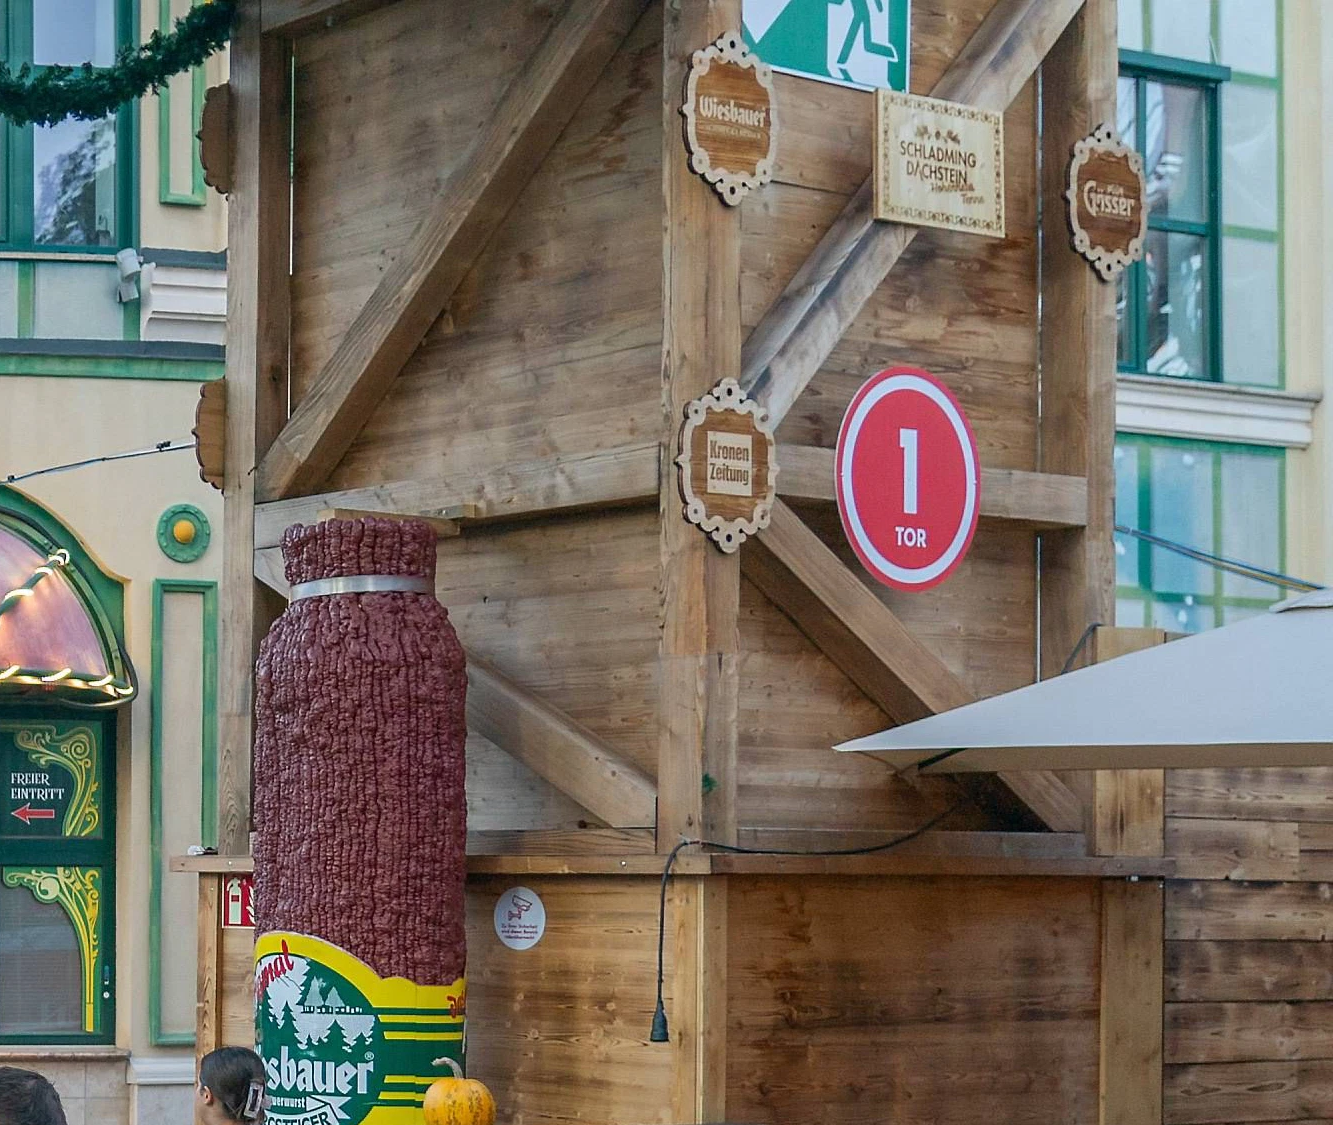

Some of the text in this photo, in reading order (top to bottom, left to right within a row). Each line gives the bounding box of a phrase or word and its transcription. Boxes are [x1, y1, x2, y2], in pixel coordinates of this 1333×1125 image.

[700, 95, 766, 127] Wiesbauer
[900, 140, 976, 168] SCHLADMING
[906, 160, 967, 184] DACHSTEIN
[710, 440, 749, 462] Kronen
[710, 463, 749, 486] Zeitung
[899, 428, 917, 514] 1
[895, 526, 927, 548] TOR
[11, 772, 50, 786] FREIER
[11, 788, 65, 801] EINTRITT
